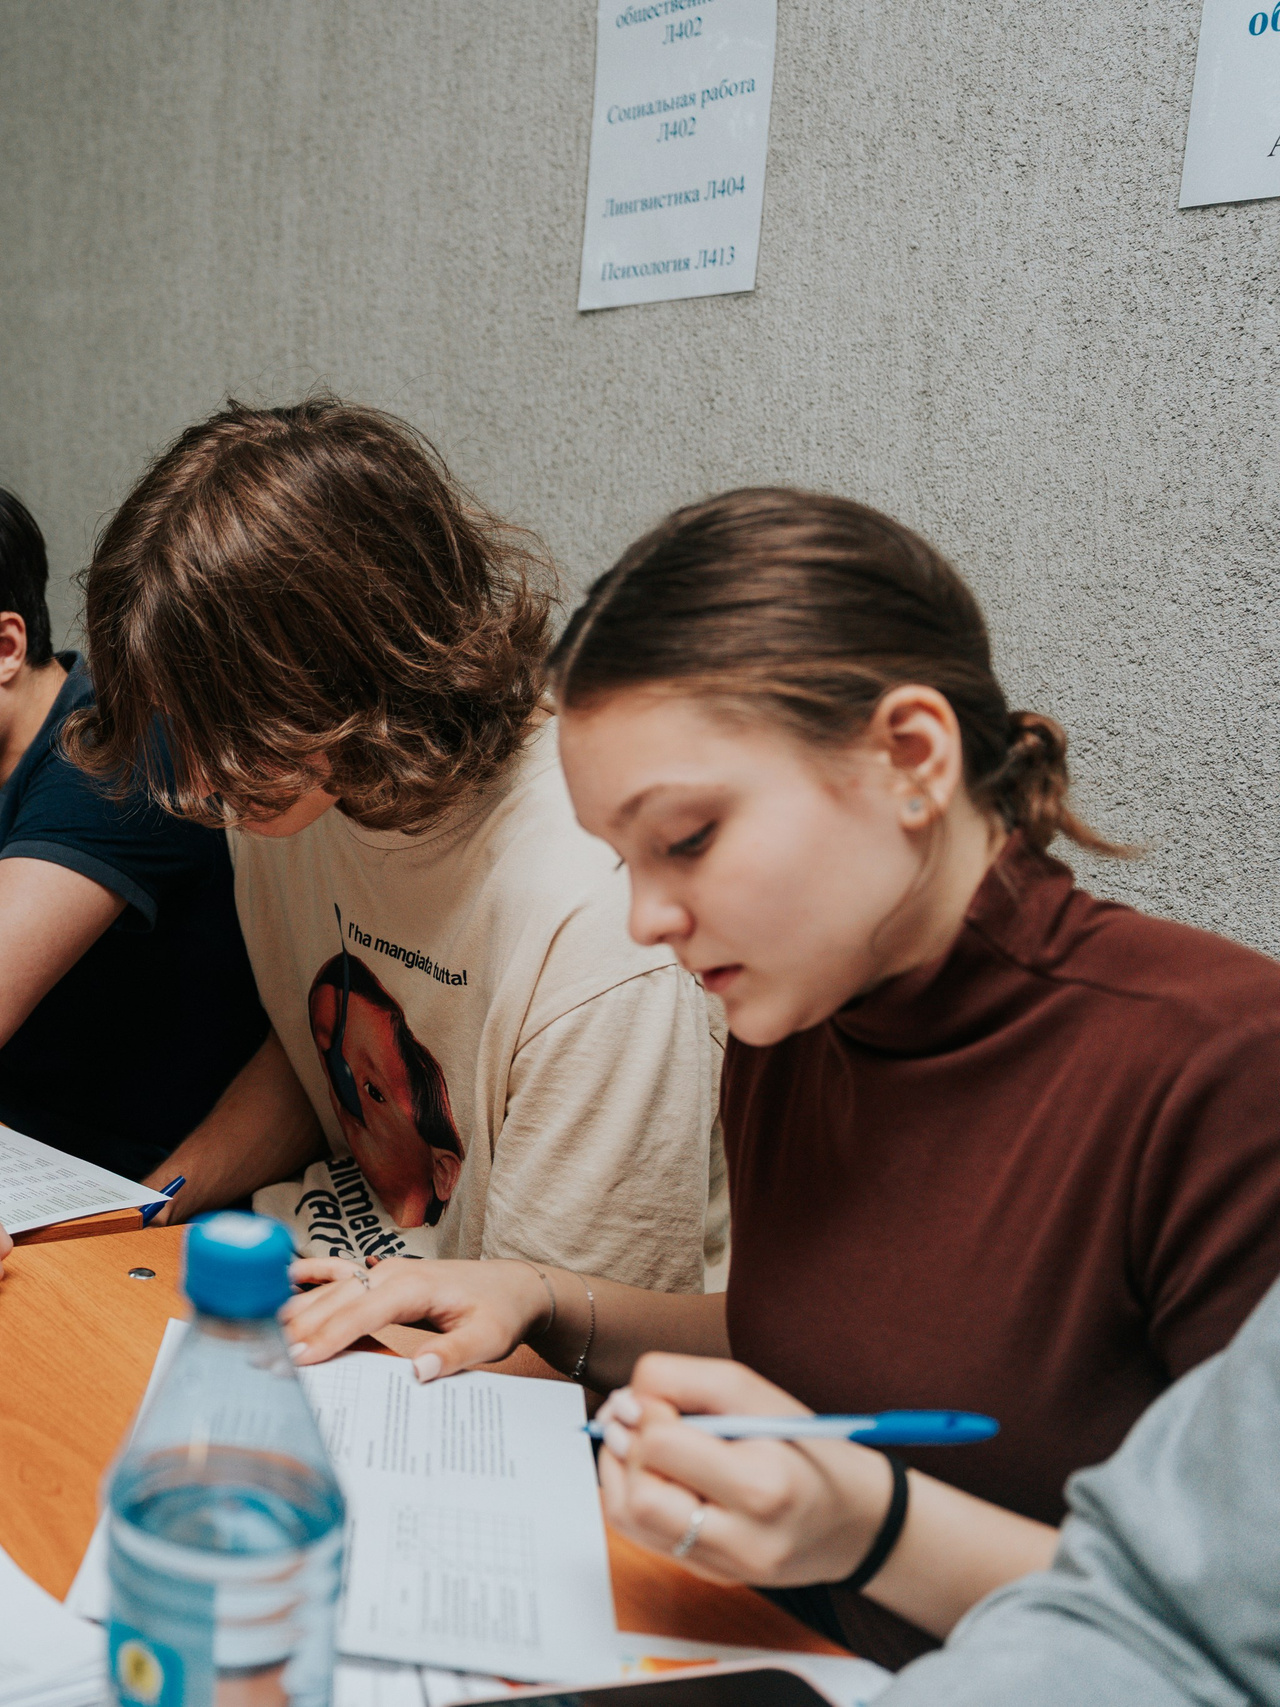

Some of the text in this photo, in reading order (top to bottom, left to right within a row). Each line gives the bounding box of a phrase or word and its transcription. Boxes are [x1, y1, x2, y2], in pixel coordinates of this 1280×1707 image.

[662, 16, 703, 45] Л402
[607, 78, 756, 125] Социальная работа
[656, 116, 697, 143] Л402
[602, 175, 746, 218] Лингвистика Л404
[601, 246, 736, 282] Психология Л413
[374, 938, 433, 975] mangiata
[433, 962, 468, 986] tutta!
